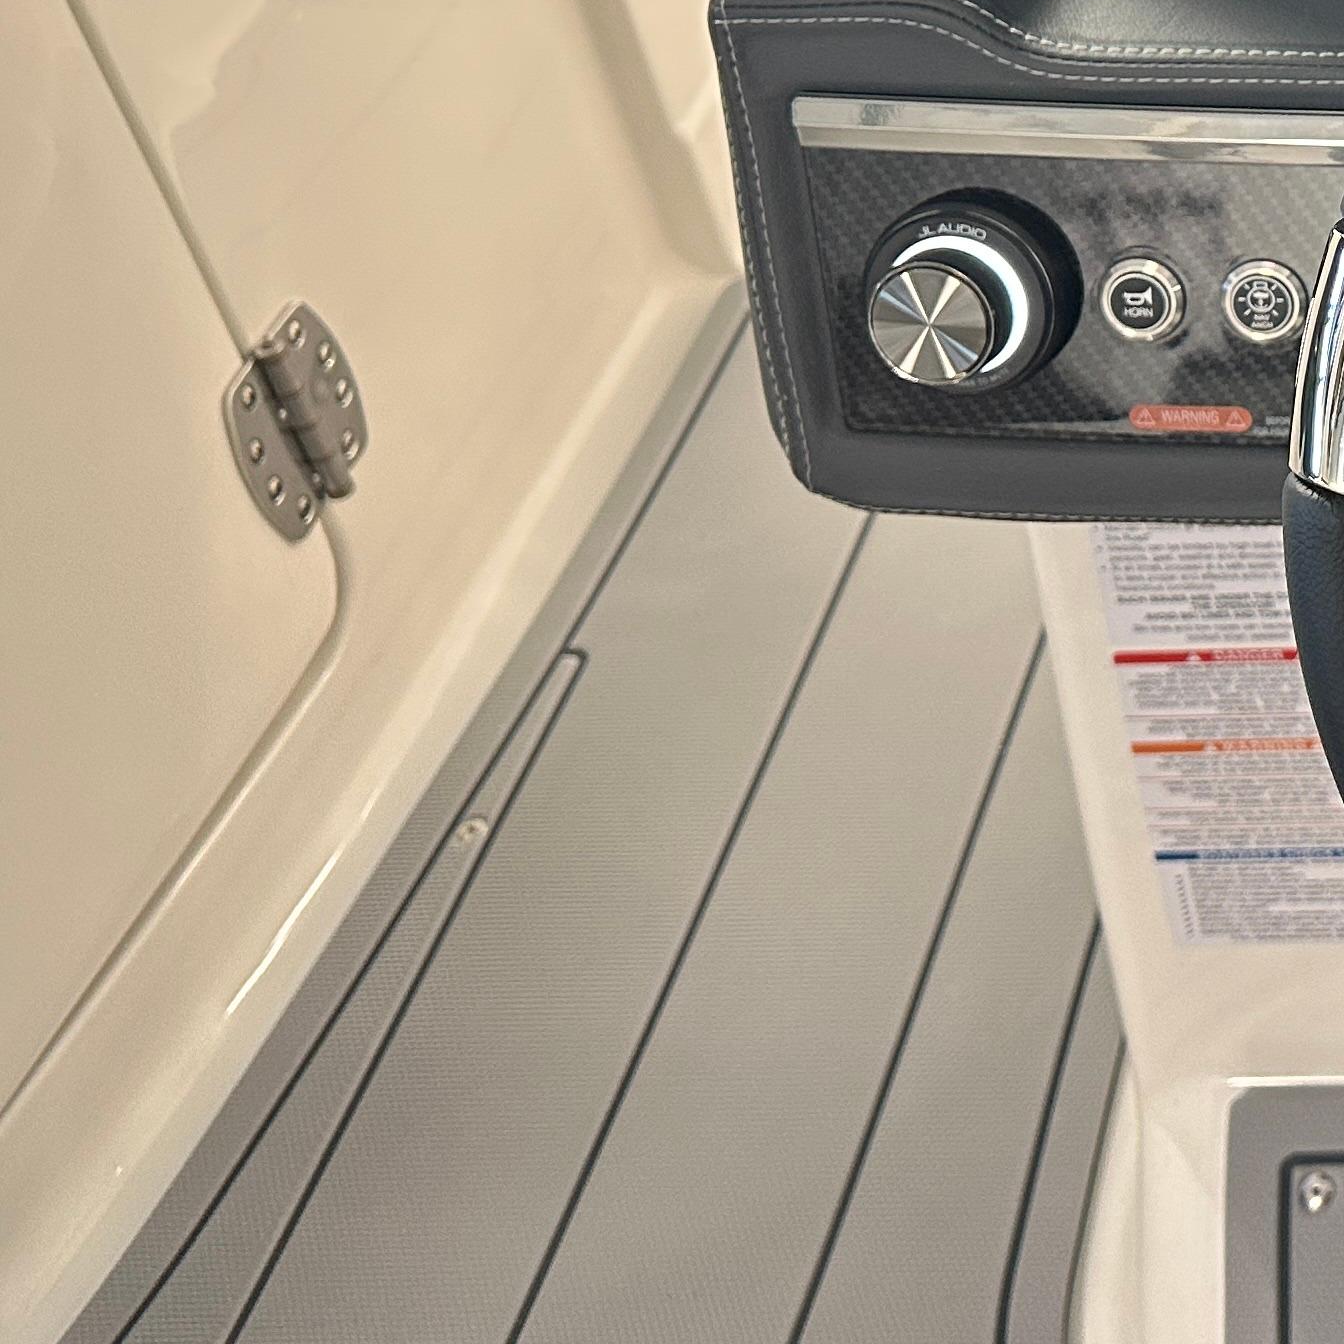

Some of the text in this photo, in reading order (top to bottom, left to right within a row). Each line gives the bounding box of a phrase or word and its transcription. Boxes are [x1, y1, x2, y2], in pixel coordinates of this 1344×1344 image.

[919, 223, 987, 241] JL AUDIO
[1124, 307, 1154, 318] HORN
[1161, 409, 1219, 424] WARNING
